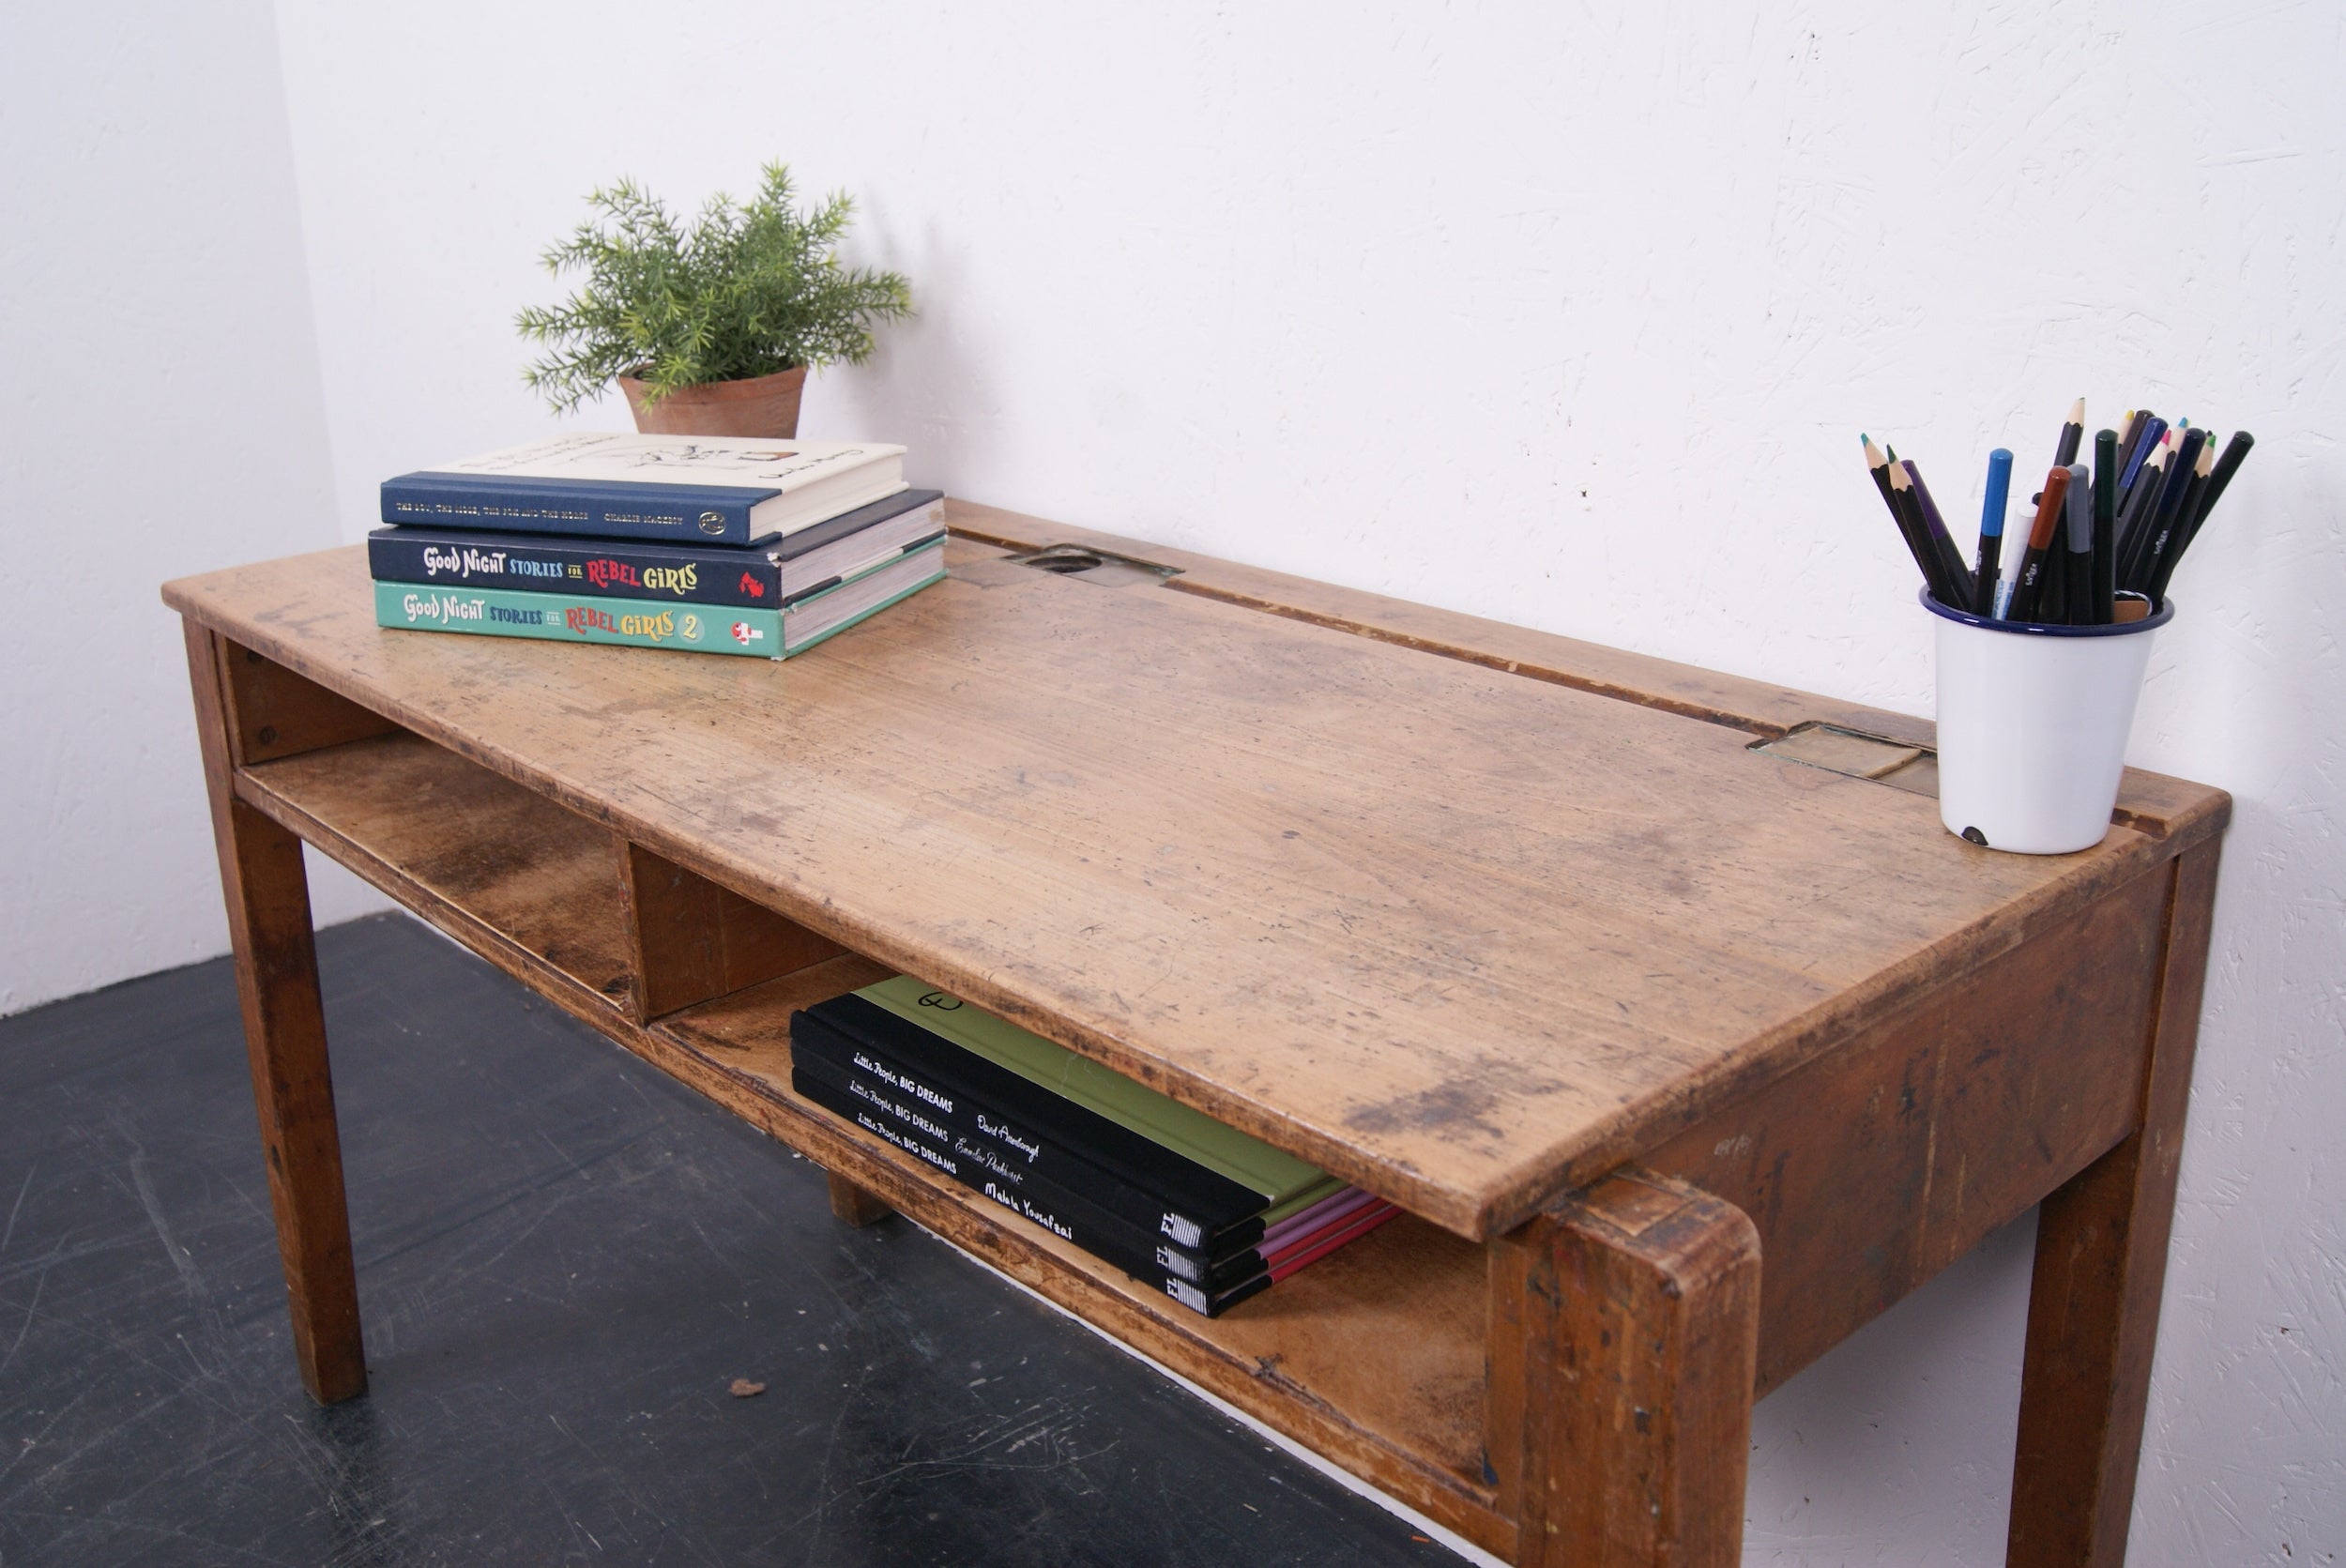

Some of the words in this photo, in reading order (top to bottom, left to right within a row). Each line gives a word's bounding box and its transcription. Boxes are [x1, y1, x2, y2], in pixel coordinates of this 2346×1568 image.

[510, 558, 563, 578] STORIES
[568, 566, 583, 577] FOR
[586, 558, 642, 589] REBEL
[490, 606, 542, 625] STORIES
[546, 613, 561, 624] FOR
[565, 606, 619, 635] REBEL
[683, 615, 698, 640] 2
[849, 1079, 869, 1100] Little
[869, 1089, 894, 1115] People,
[895, 1104, 911, 1122] BIG
[912, 1113, 949, 1143] DREAMS
[853, 1052, 874, 1072] Little
[874, 1061, 898, 1087] People,
[899, 1075, 915, 1093] BIG
[916, 1085, 953, 1114] DREAMS
[857, 1112, 877, 1132] Little
[876, 1122, 903, 1147] People,
[903, 1136, 920, 1154] BIG
[921, 1146, 957, 1175] DREAMS
[984, 1182, 1020, 1212] Malala
[1023, 1199, 1073, 1241] Yousafzai
